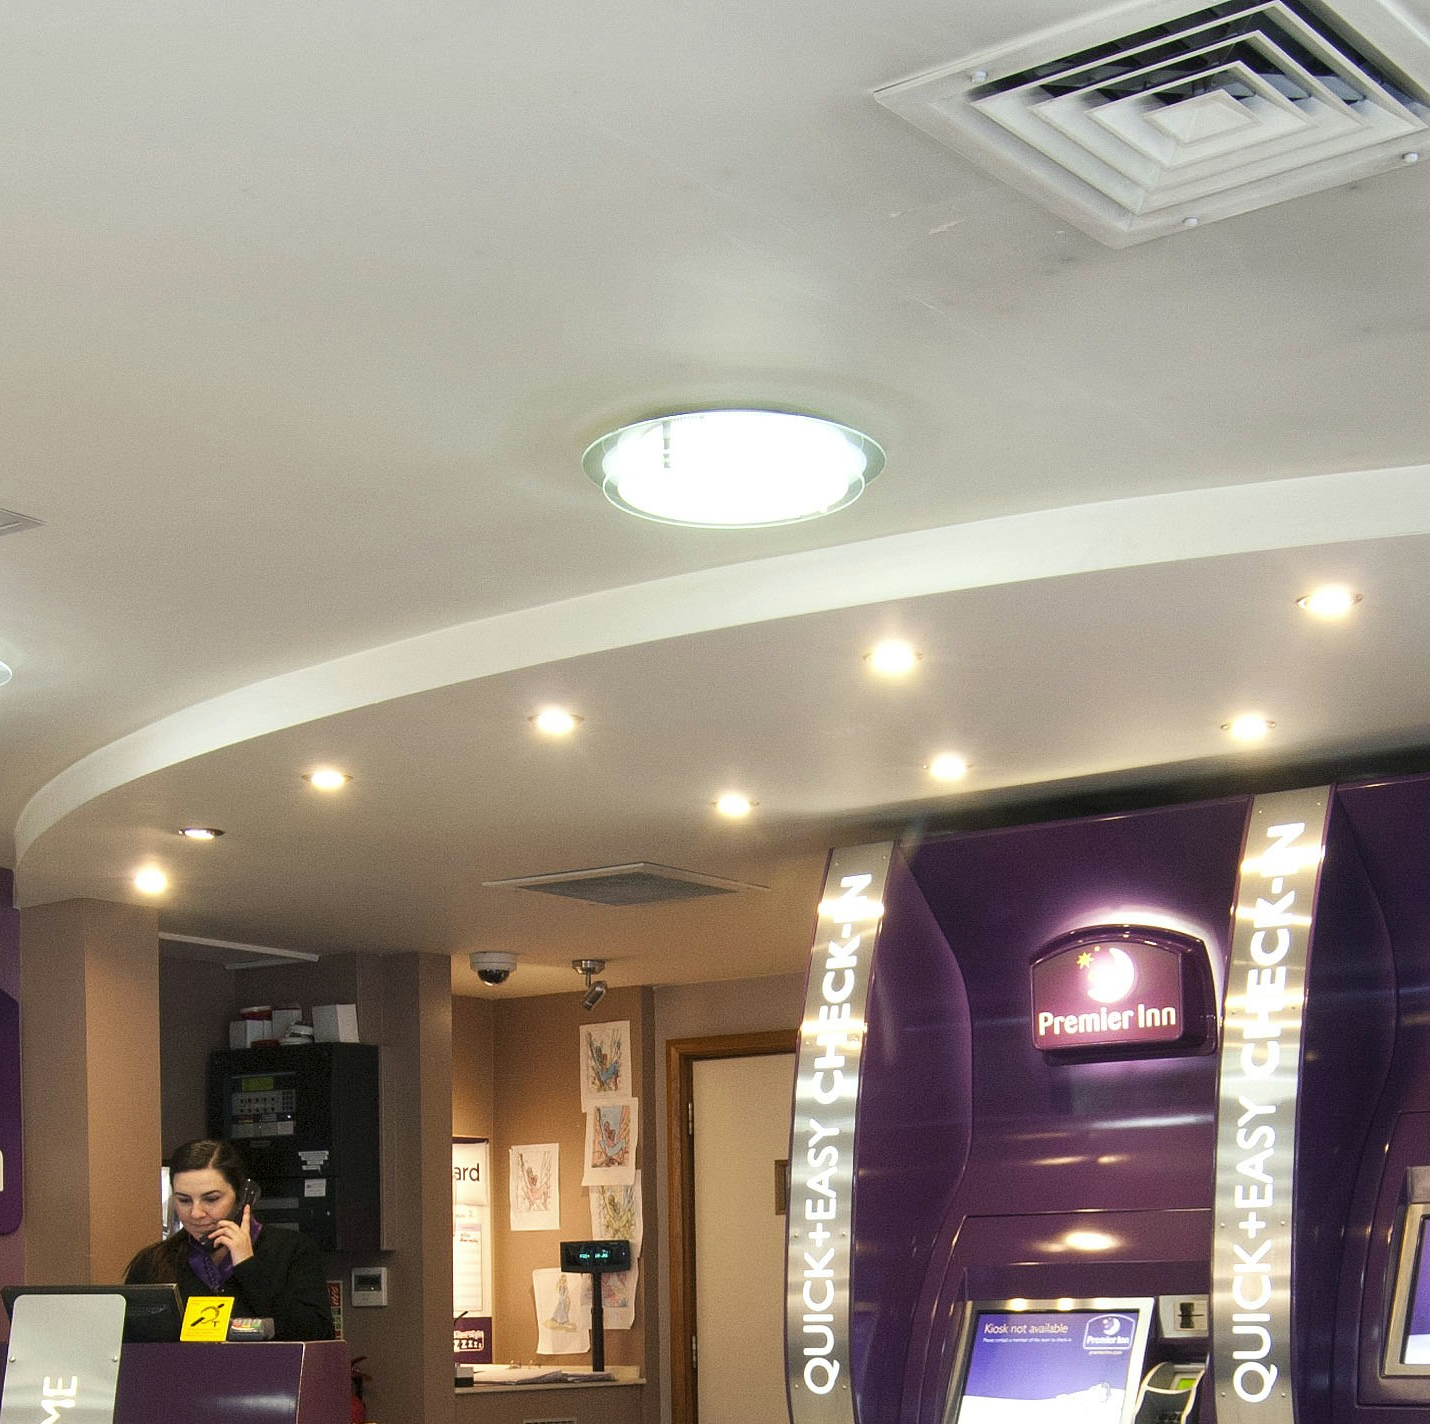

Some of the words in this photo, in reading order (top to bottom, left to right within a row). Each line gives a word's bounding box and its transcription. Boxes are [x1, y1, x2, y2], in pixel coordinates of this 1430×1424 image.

[1038, 1006, 1134, 1036] Premier
[1137, 1003, 1176, 1028] Inn
[984, 1323, 1008, 1333] Kiosk
[1011, 1324, 1027, 1333] not
[1029, 1322, 1069, 1333] available
